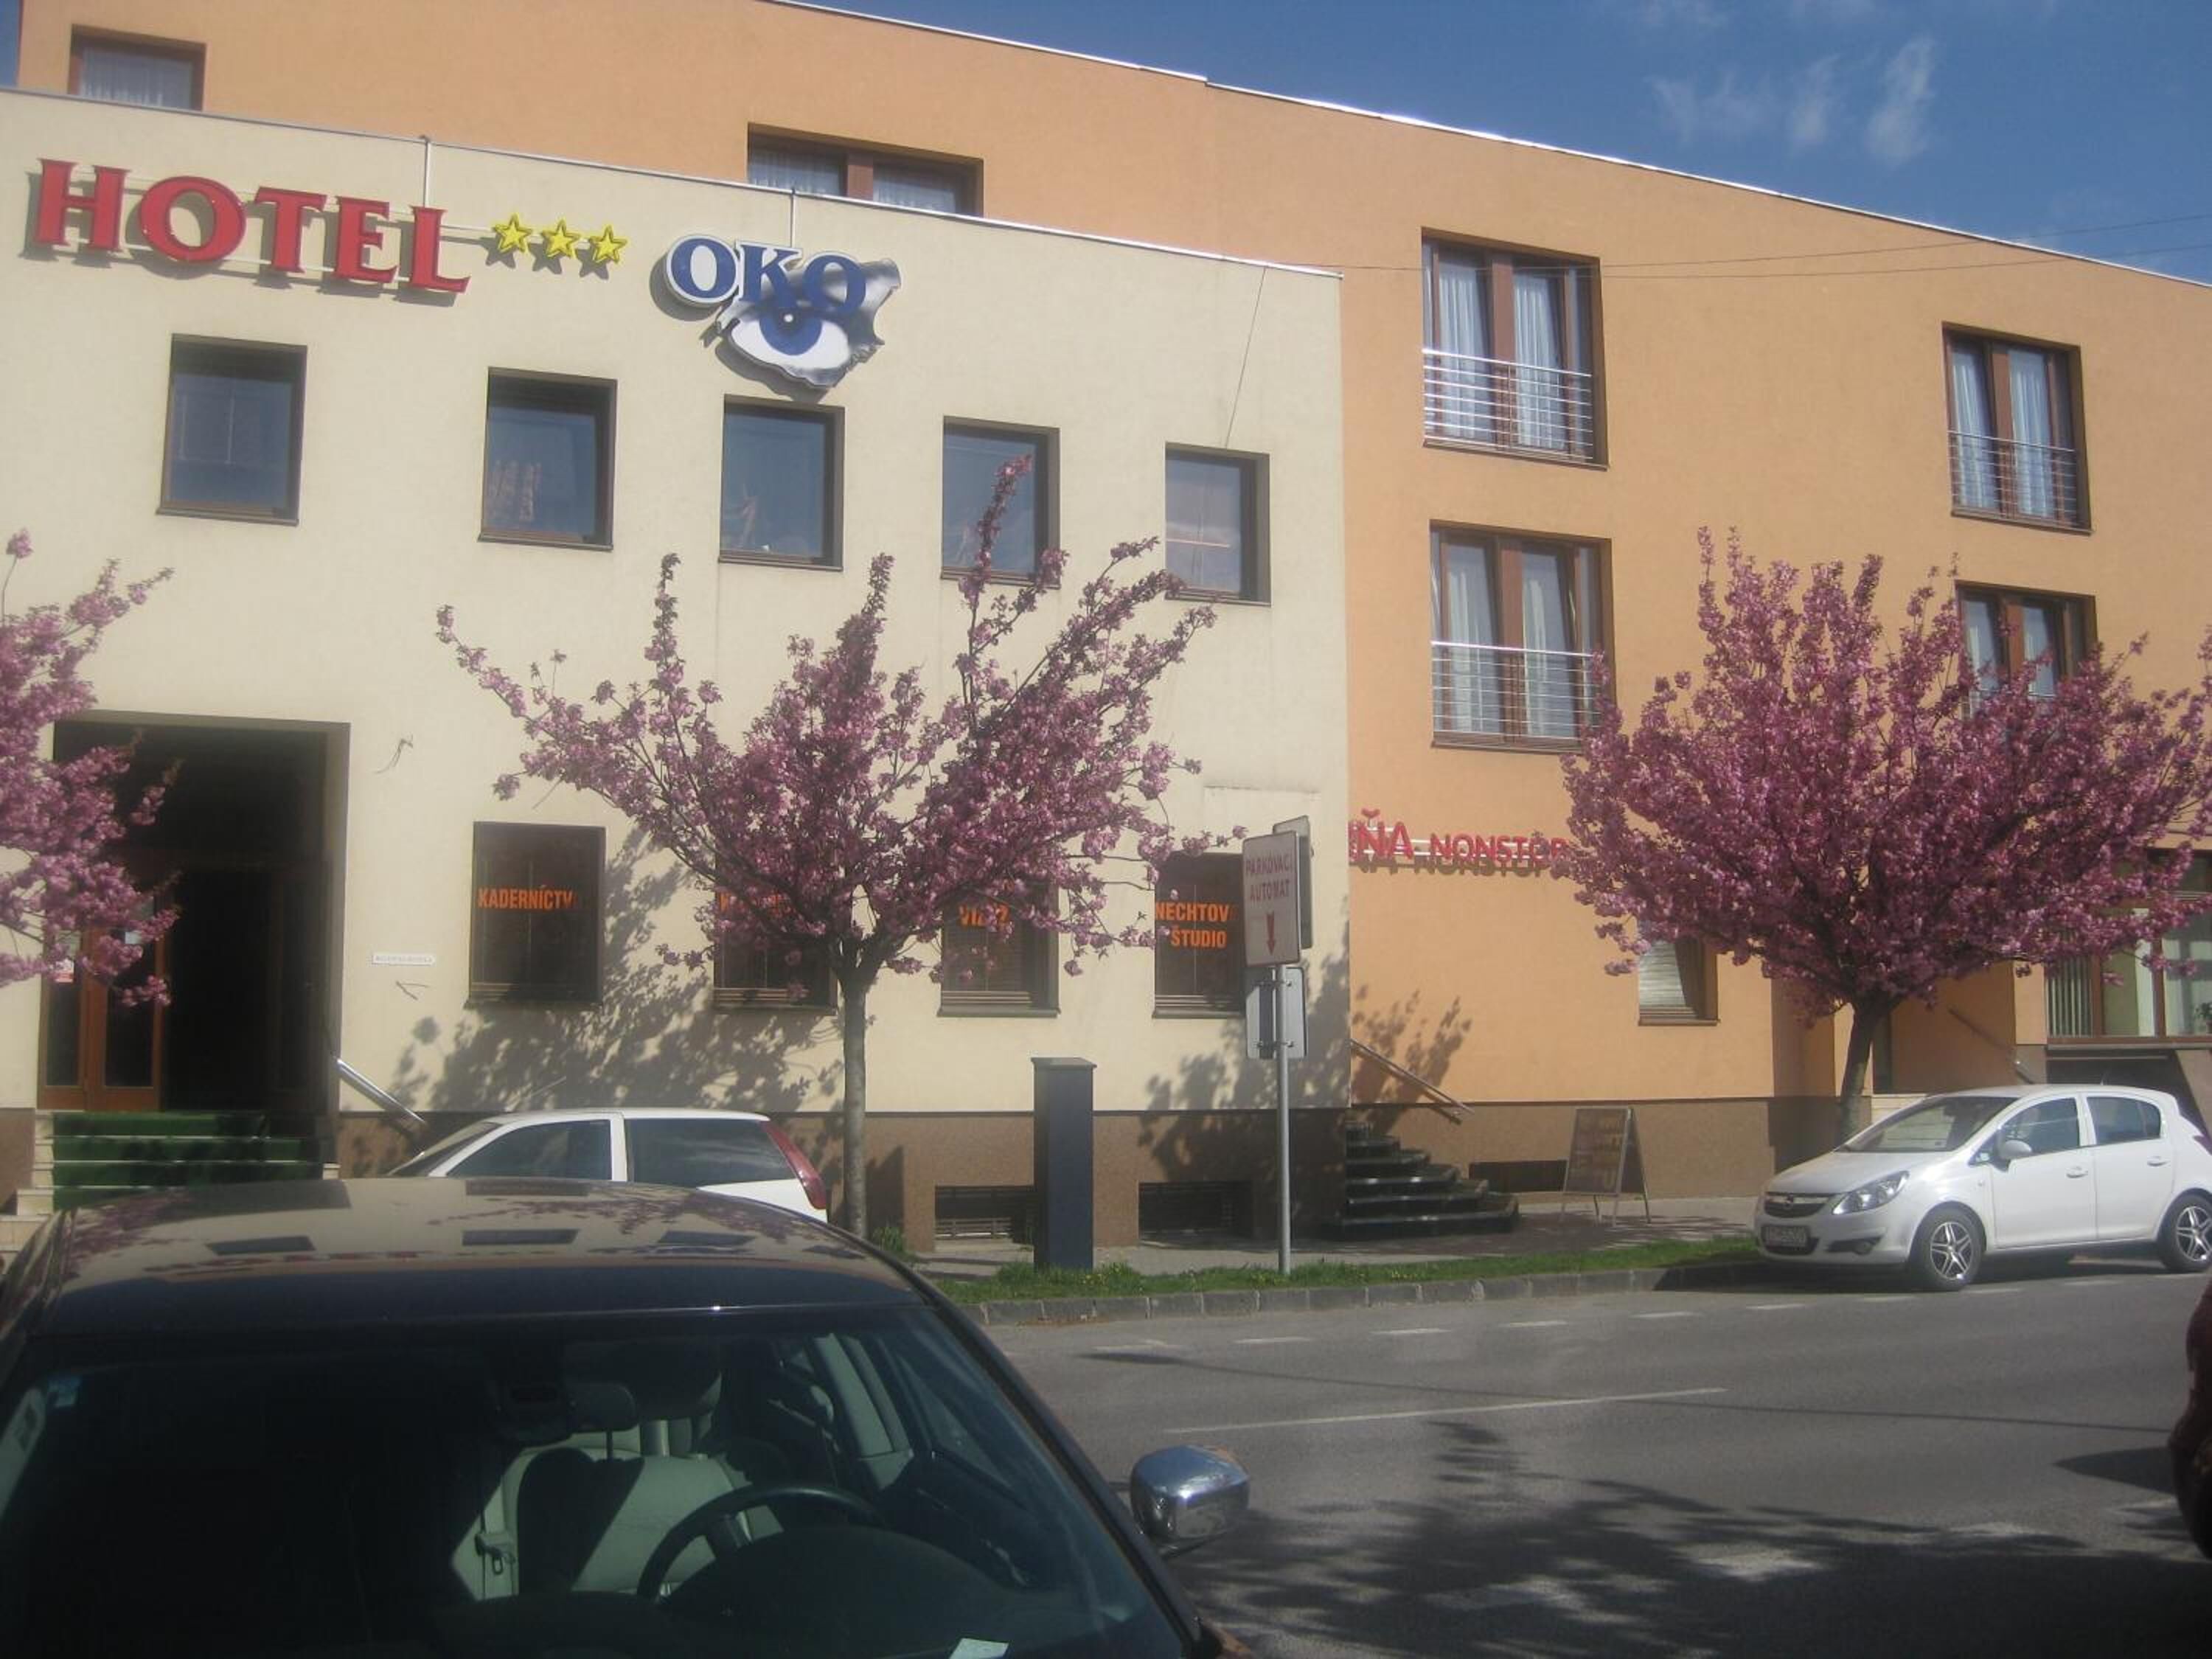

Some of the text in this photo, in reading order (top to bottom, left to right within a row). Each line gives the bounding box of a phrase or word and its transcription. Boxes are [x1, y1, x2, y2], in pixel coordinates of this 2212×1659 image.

[37, 158, 471, 294] HOTEL
[667, 235, 868, 316] OKO
[1251, 879, 1290, 901] AUTOMAT
